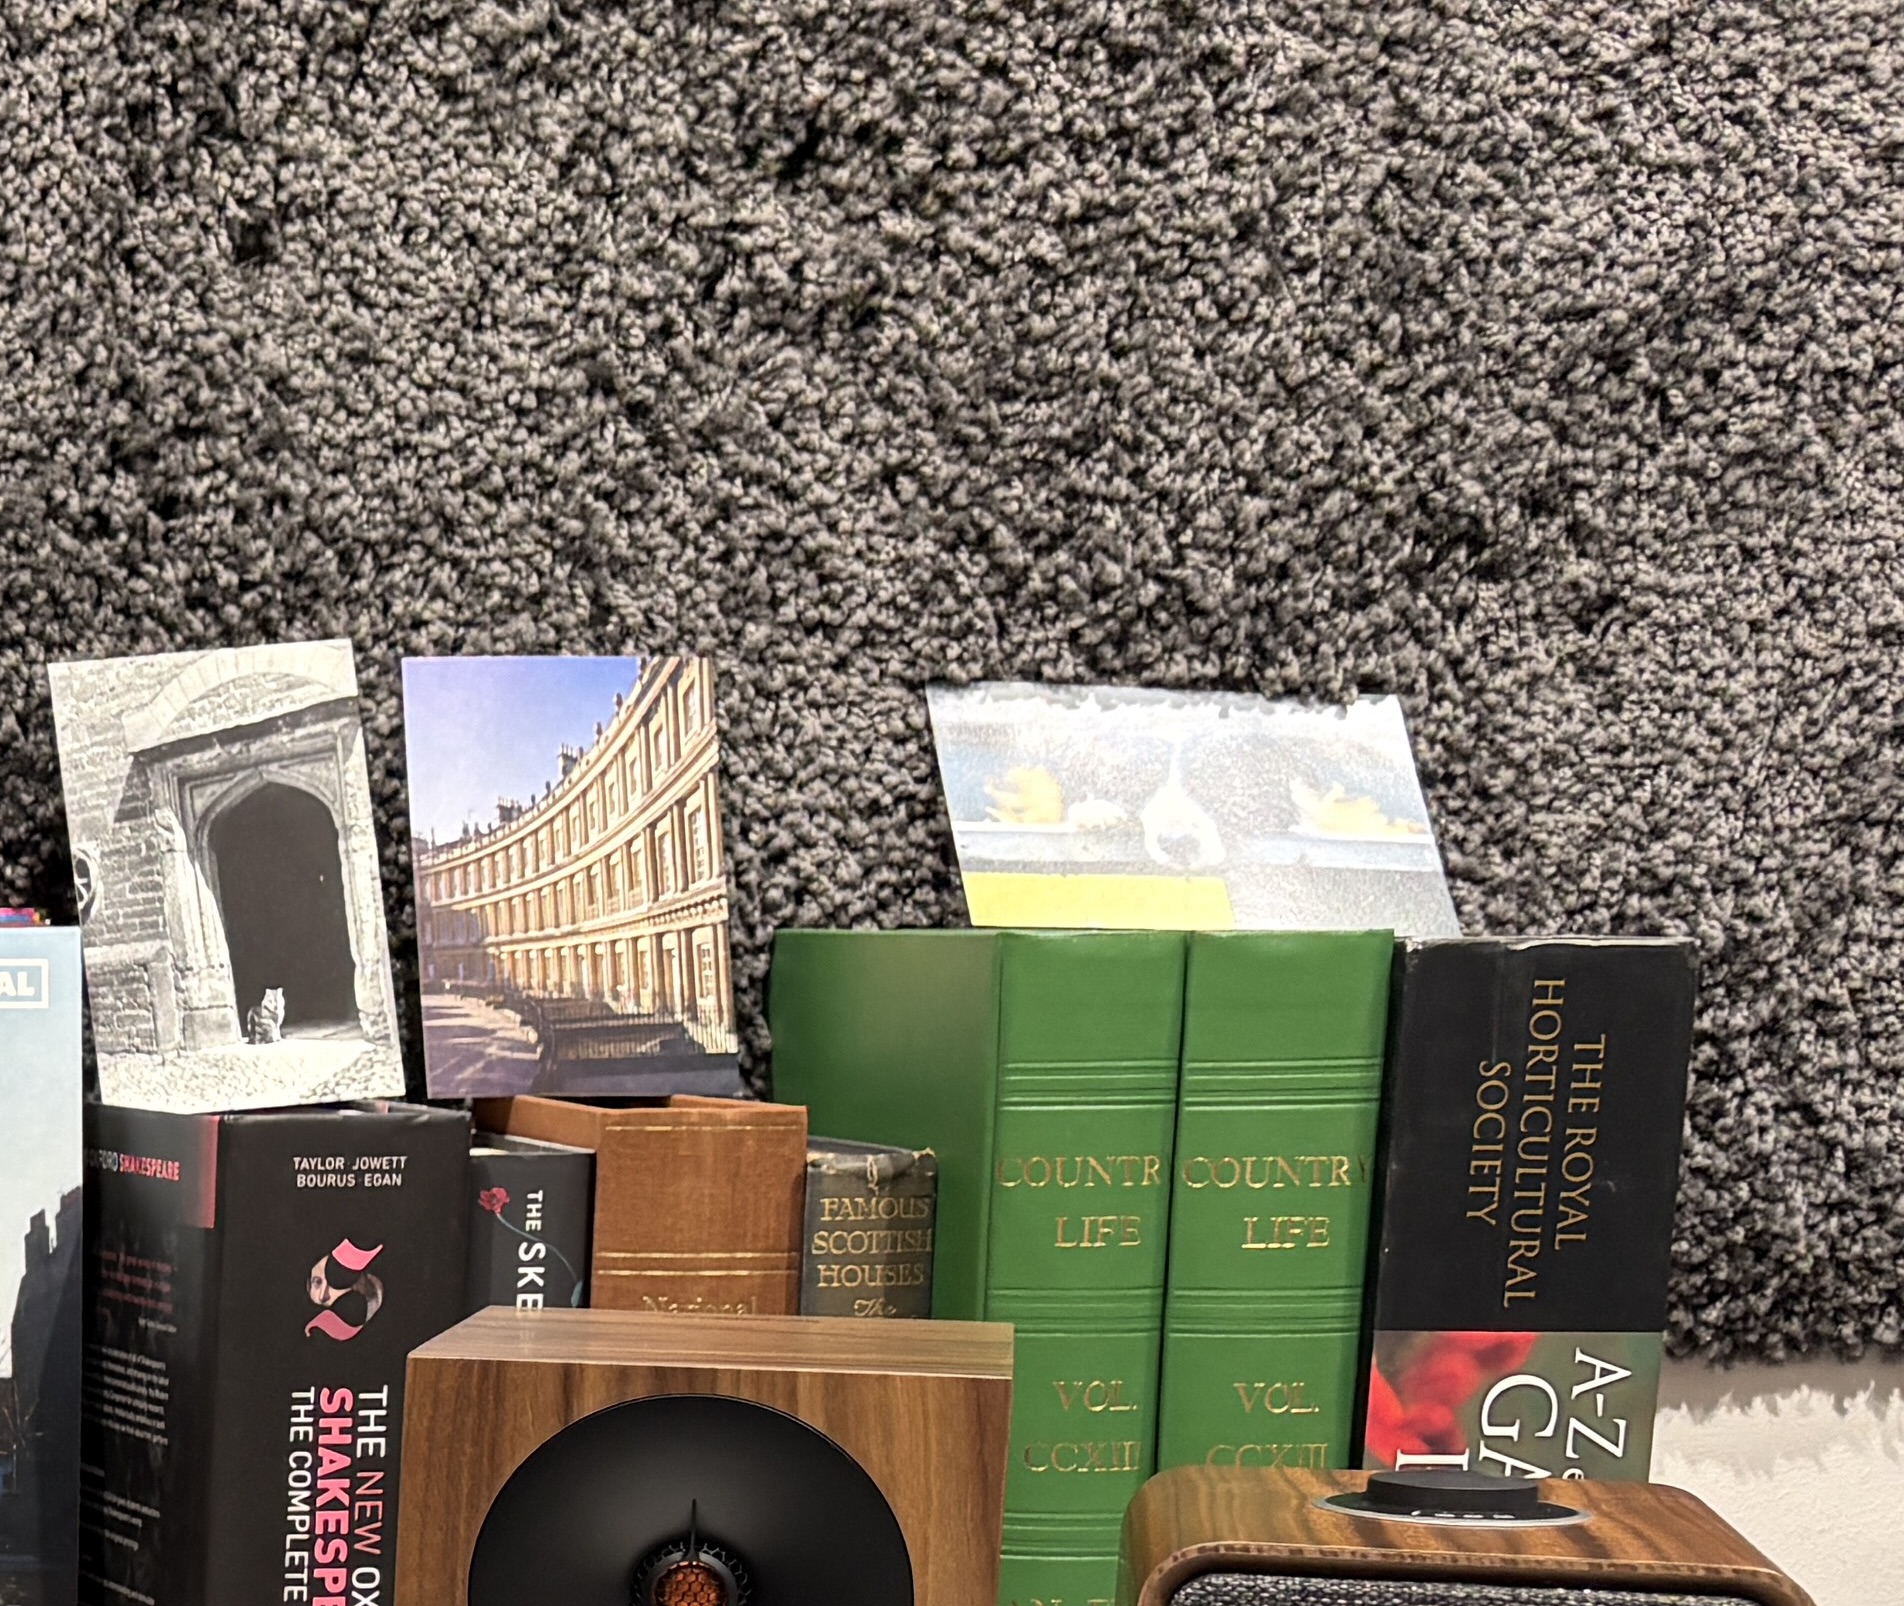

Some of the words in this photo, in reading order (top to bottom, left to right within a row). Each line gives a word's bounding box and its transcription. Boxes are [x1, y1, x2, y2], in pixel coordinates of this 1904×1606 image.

[1573, 1033, 1606, 1115] THE
[1467, 1060, 1512, 1226] SOCIETY
[1503, 978, 1566, 1308] HORTICULTURAL
[119, 1153, 180, 1181] SHAKESPEARE
[293, 1156, 345, 1171] TAYLOR
[352, 1156, 408, 1171] JOWETT
[296, 1173, 356, 1188] BOURUS
[363, 1172, 403, 1188] EGAN
[1554, 1122, 1598, 1250] ROYAL
[525, 1189, 544, 1232] THE
[820, 1197, 930, 1221] FAMOUS
[811, 1230, 933, 1256] SCOTTISH
[1054, 1216, 1141, 1248] LIFE
[1241, 1216, 1331, 1249] LIFE
[816, 1263, 925, 1289] HOUSES
[1053, 1380, 1138, 1412] VOL.
[1233, 1382, 1320, 1414] VOL.
[1565, 1347, 1633, 1460] A-Z
[289, 1386, 316, 1443] THE
[356, 1385, 389, 1459] THE
[1023, 1440, 1141, 1473] CCXIII
[283, 1450, 313, 1603] COMPLETE
[353, 1471, 385, 1555] NEW
